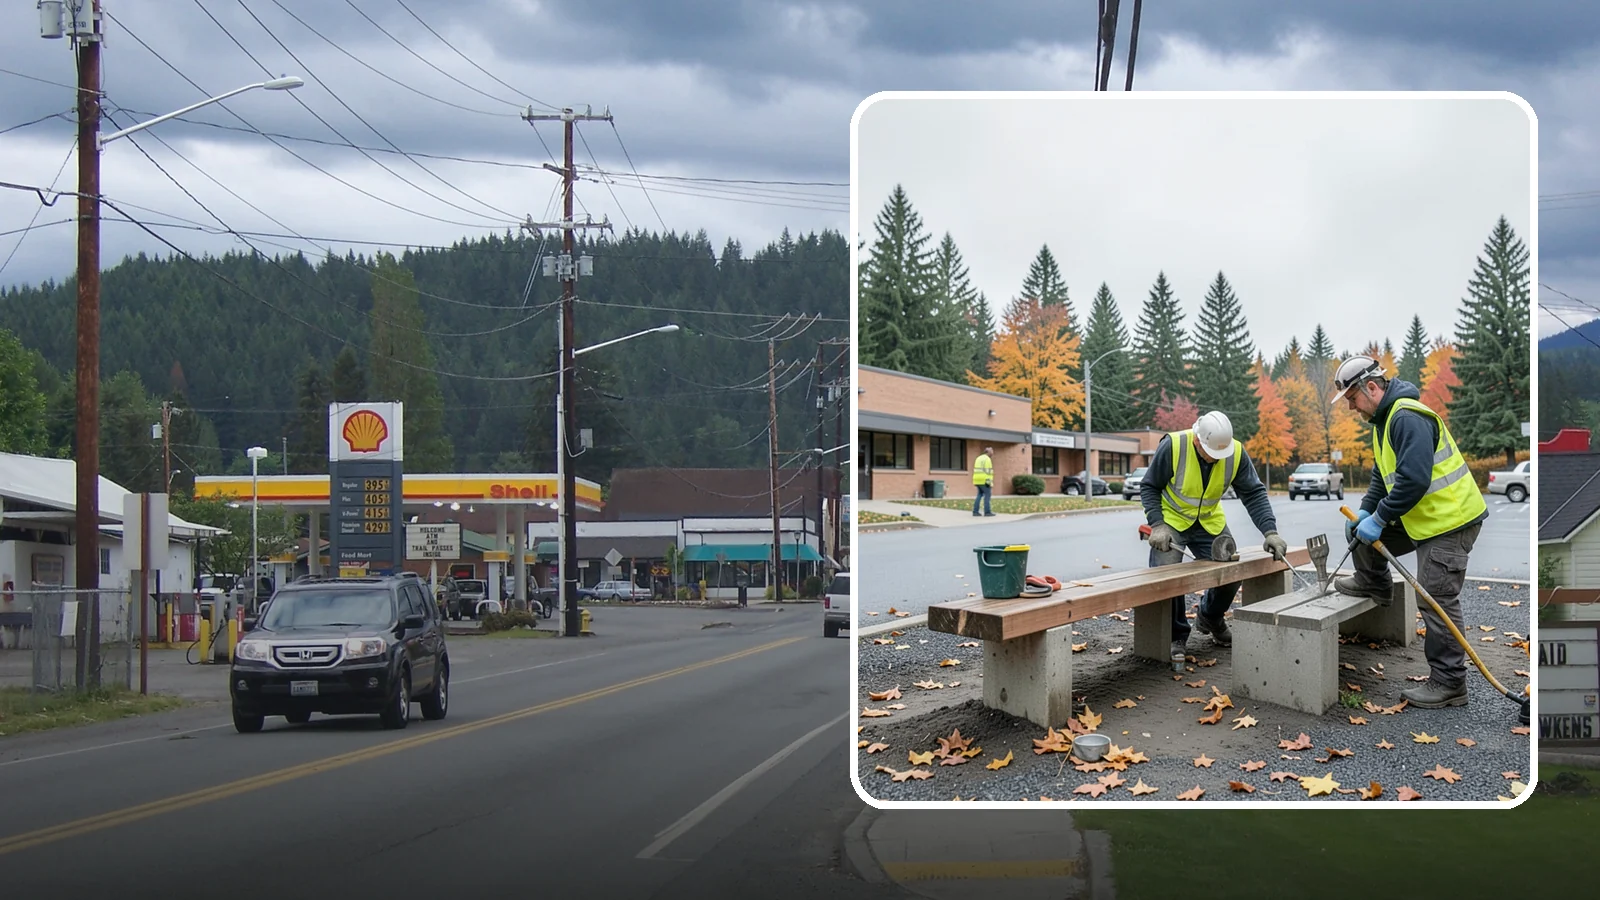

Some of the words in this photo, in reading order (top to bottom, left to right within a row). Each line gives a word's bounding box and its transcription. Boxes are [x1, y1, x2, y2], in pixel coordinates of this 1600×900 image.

[366, 480, 383, 490] 395
[490, 484, 547, 499] Shell
[366, 494, 383, 503] 405
[366, 508, 383, 517] 415
[366, 522, 383, 532] 429
